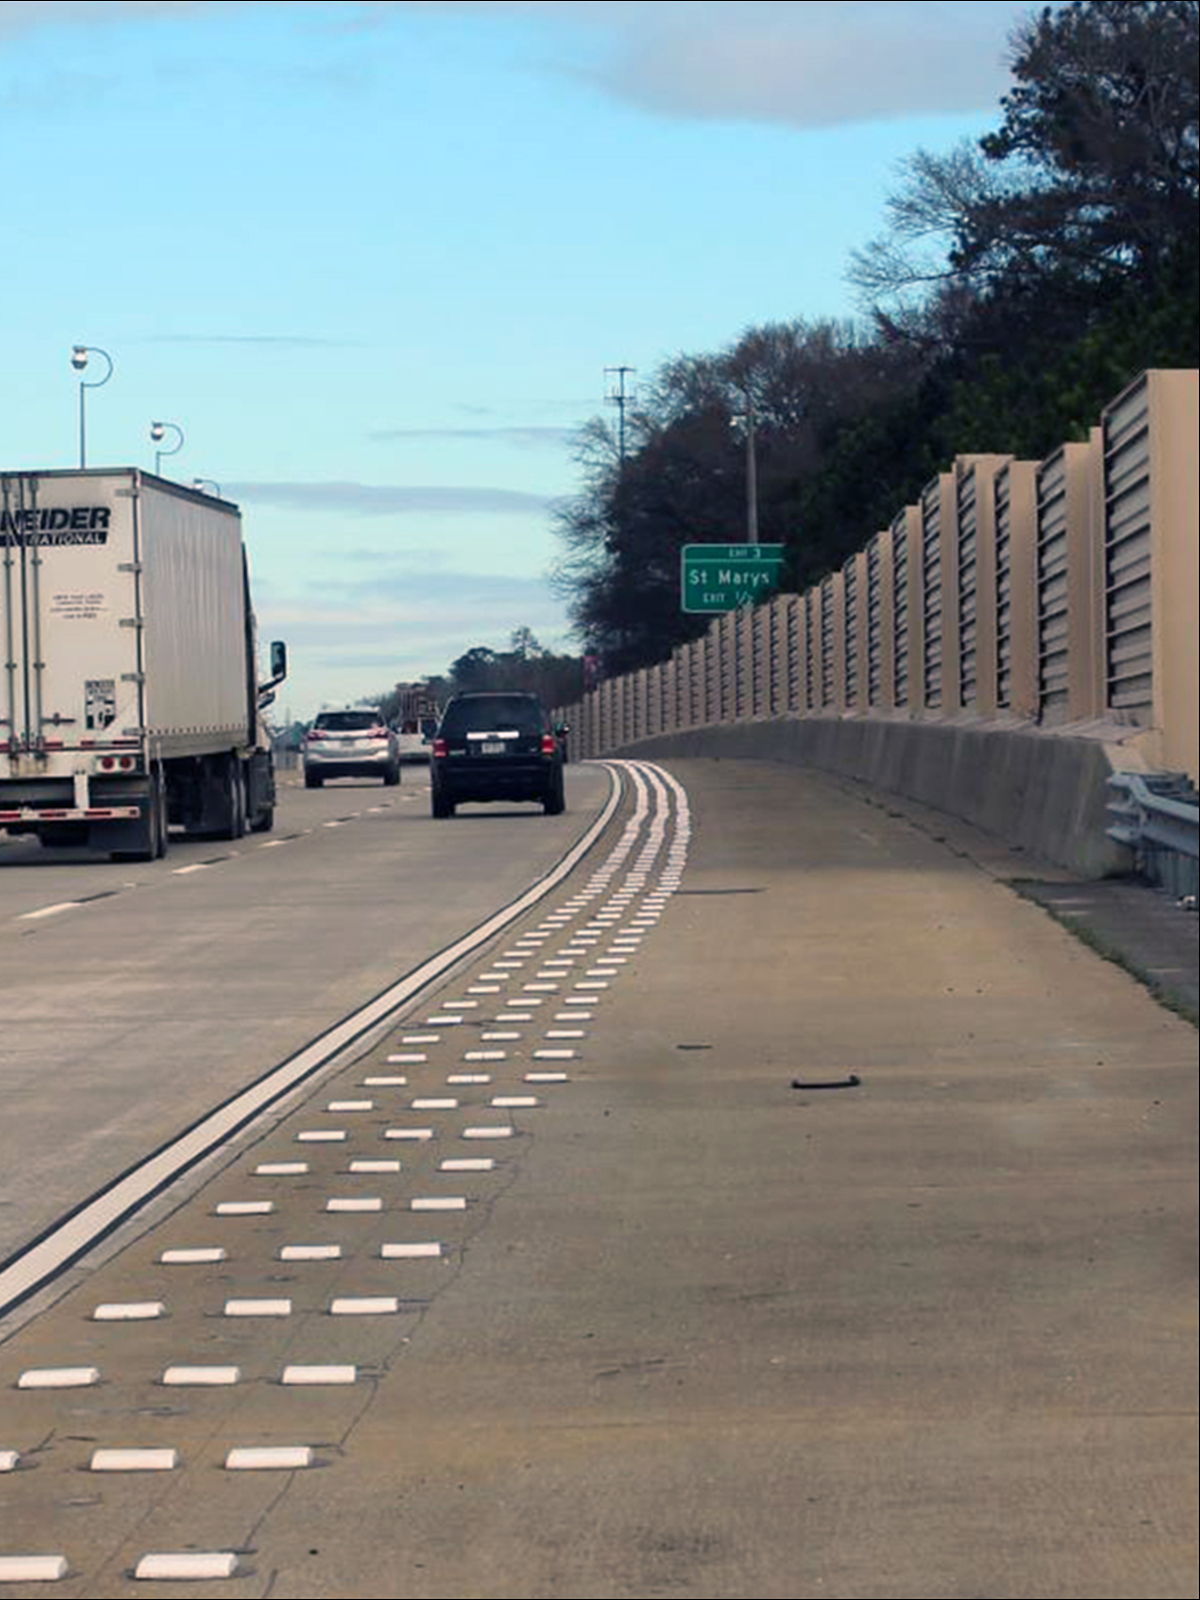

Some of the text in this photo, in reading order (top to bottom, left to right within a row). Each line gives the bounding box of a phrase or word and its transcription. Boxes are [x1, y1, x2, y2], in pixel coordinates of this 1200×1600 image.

[753, 548, 761, 558] 3
[689, 569, 770, 587] St Marys
[703, 592, 726, 603] EXIT
